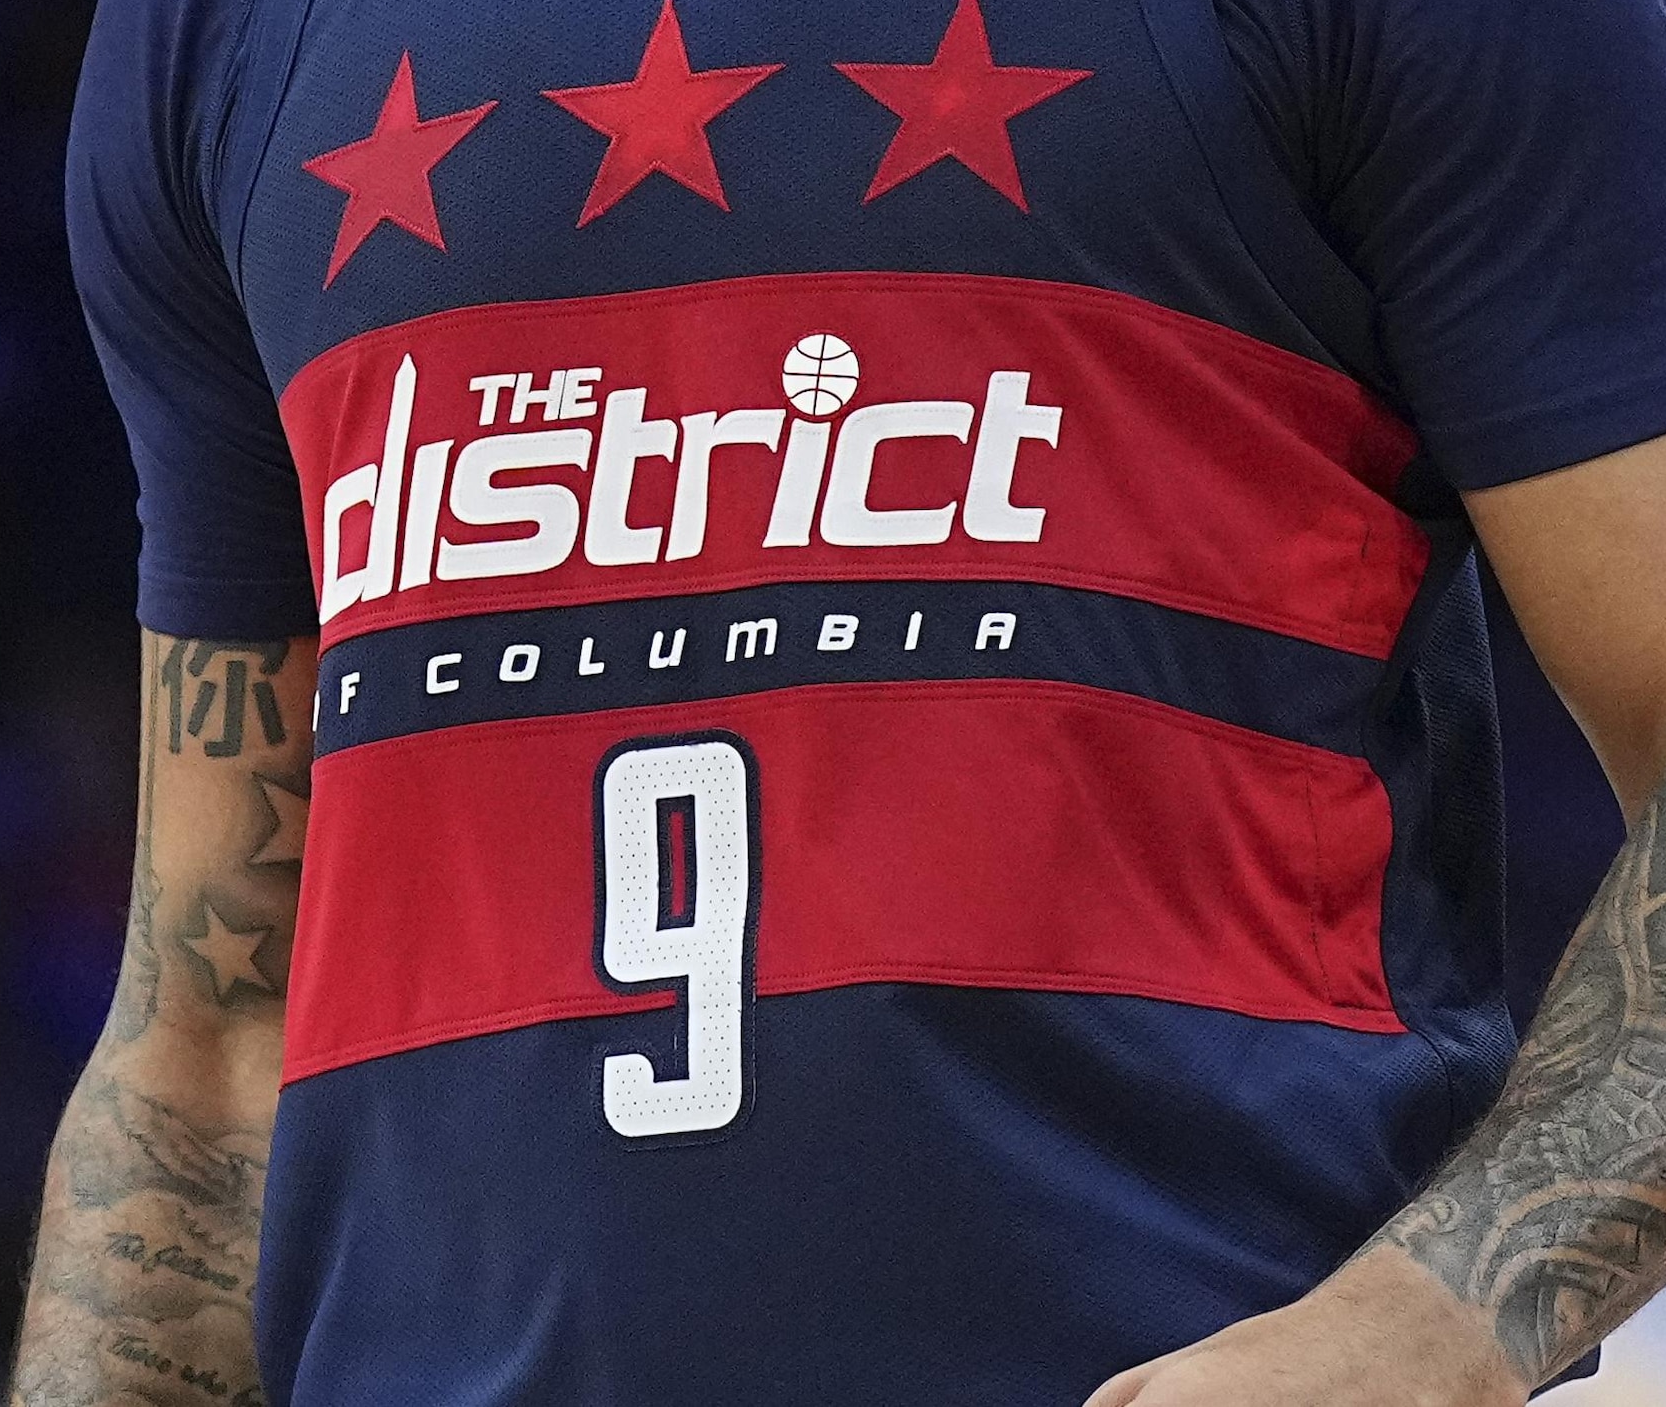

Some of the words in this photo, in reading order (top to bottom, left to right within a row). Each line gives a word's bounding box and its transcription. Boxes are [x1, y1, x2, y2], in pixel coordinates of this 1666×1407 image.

[319, 333, 1062, 625] district
[468, 367, 603, 426] THE
[425, 610, 1017, 695] COLUMBIA
[602, 741, 749, 1137] 9
